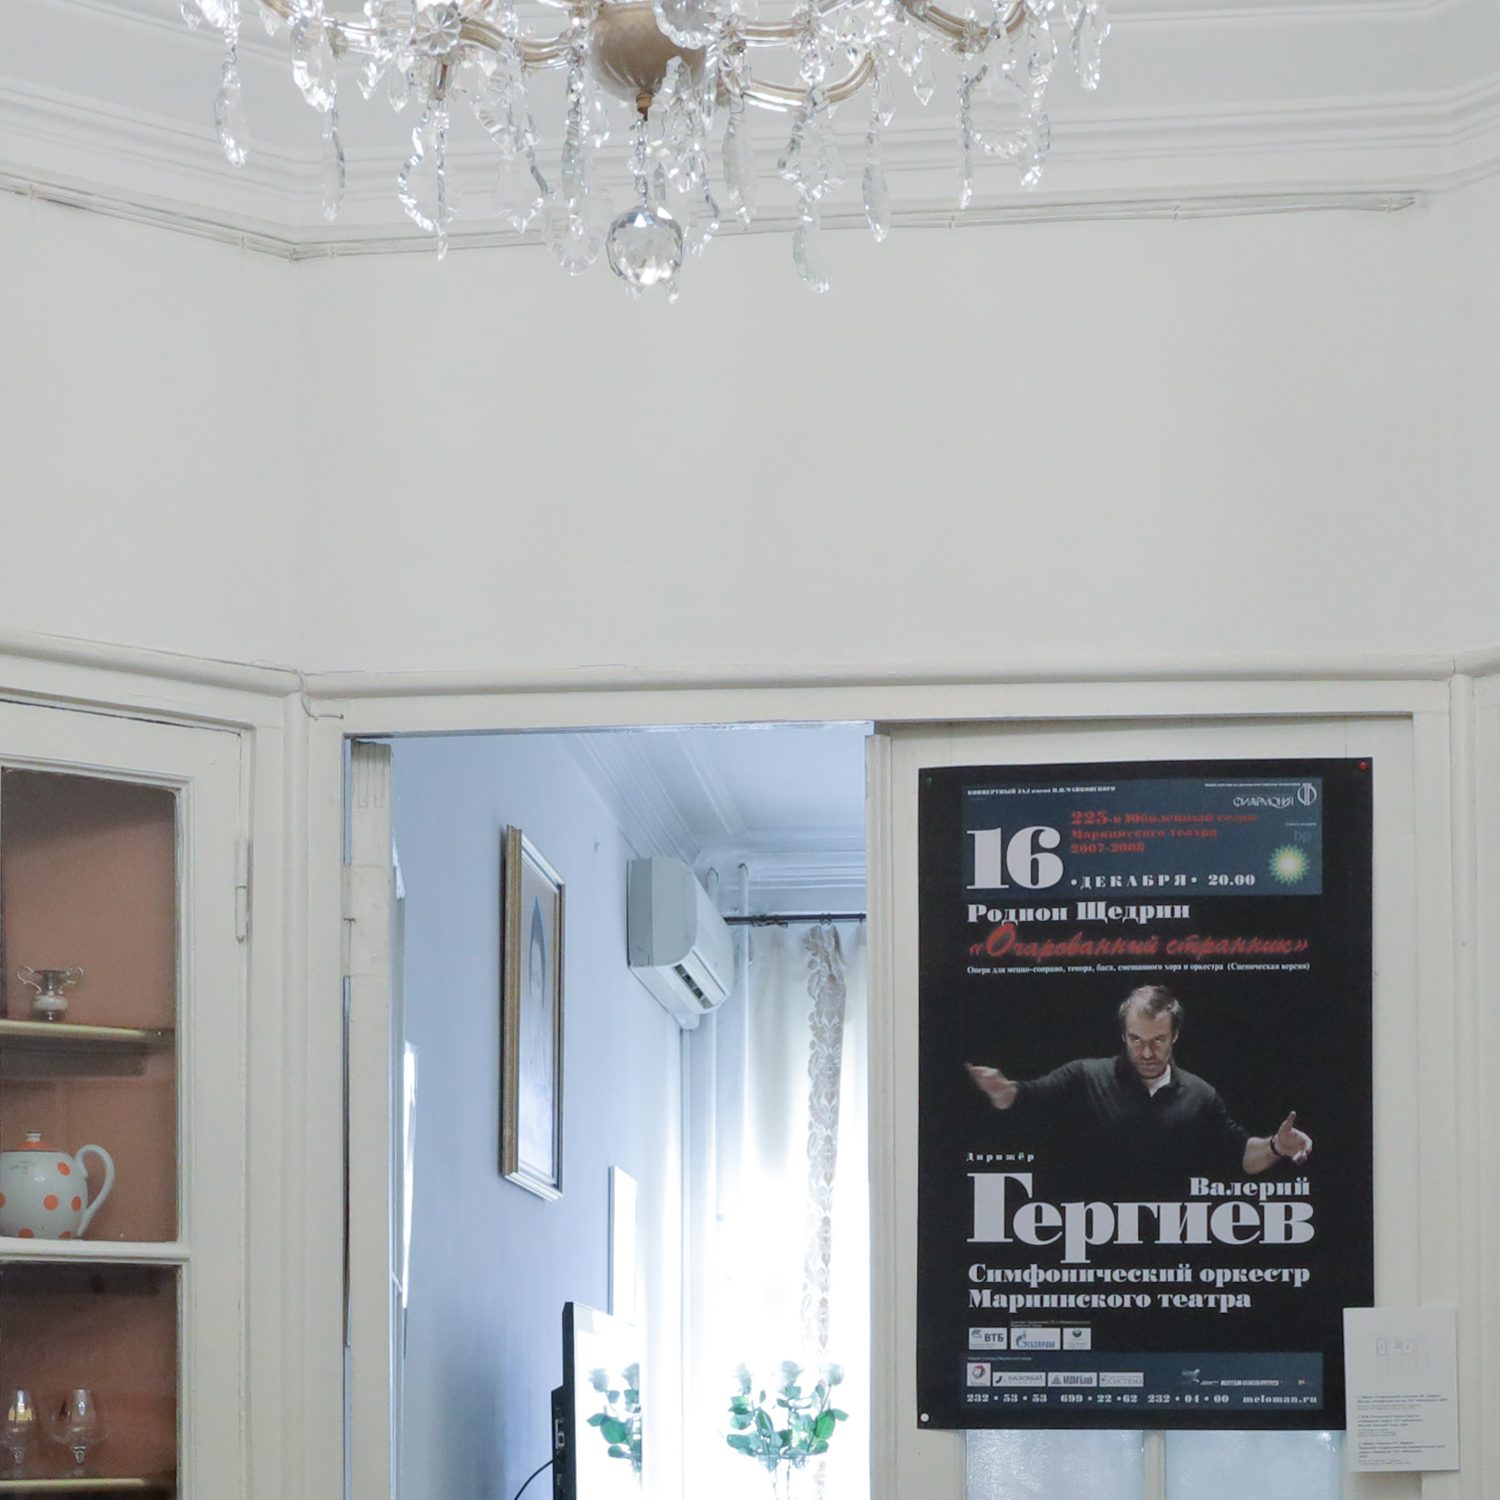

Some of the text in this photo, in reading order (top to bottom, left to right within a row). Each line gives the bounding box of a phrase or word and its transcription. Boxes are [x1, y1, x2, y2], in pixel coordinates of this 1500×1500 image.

[1125, 813, 1214, 824] Юбилейный
[1169, 828, 1218, 840] театра
[966, 825, 1066, 890] 16
[1208, 873, 1257, 887] 20.00
[967, 901, 1191, 927] Родион Щедрин
[969, 922, 1160, 963] «Очарованный
[967, 965, 991, 976] Опера
[991, 966, 1006, 974] для
[1164, 963, 1182, 972] хора
[1227, 961, 1280, 971] (Сценическая
[966, 1152, 1036, 1163] Дирижёр
[1189, 1176, 1311, 1199] Валерий
[966, 1171, 1316, 1264] Гергиев
[968, 1263, 1311, 1288] Симфонический оркестр
[968, 1289, 1253, 1314] Мариинского театра
[984, 1333, 1005, 1343] ВТБ
[966, 1393, 990, 1403] 232
[1002, 1393, 1019, 1403] 53
[1032, 1393, 1048, 1403] 53
[1060, 1393, 1084, 1403] 699
[1096, 1393, 1113, 1403] 22
[1122, 1393, 1138, 1403] 62
[1147, 1394, 1171, 1403] 232
[1213, 1394, 1230, 1403] 00
[1242, 1393, 1318, 1403] meloman.ru
